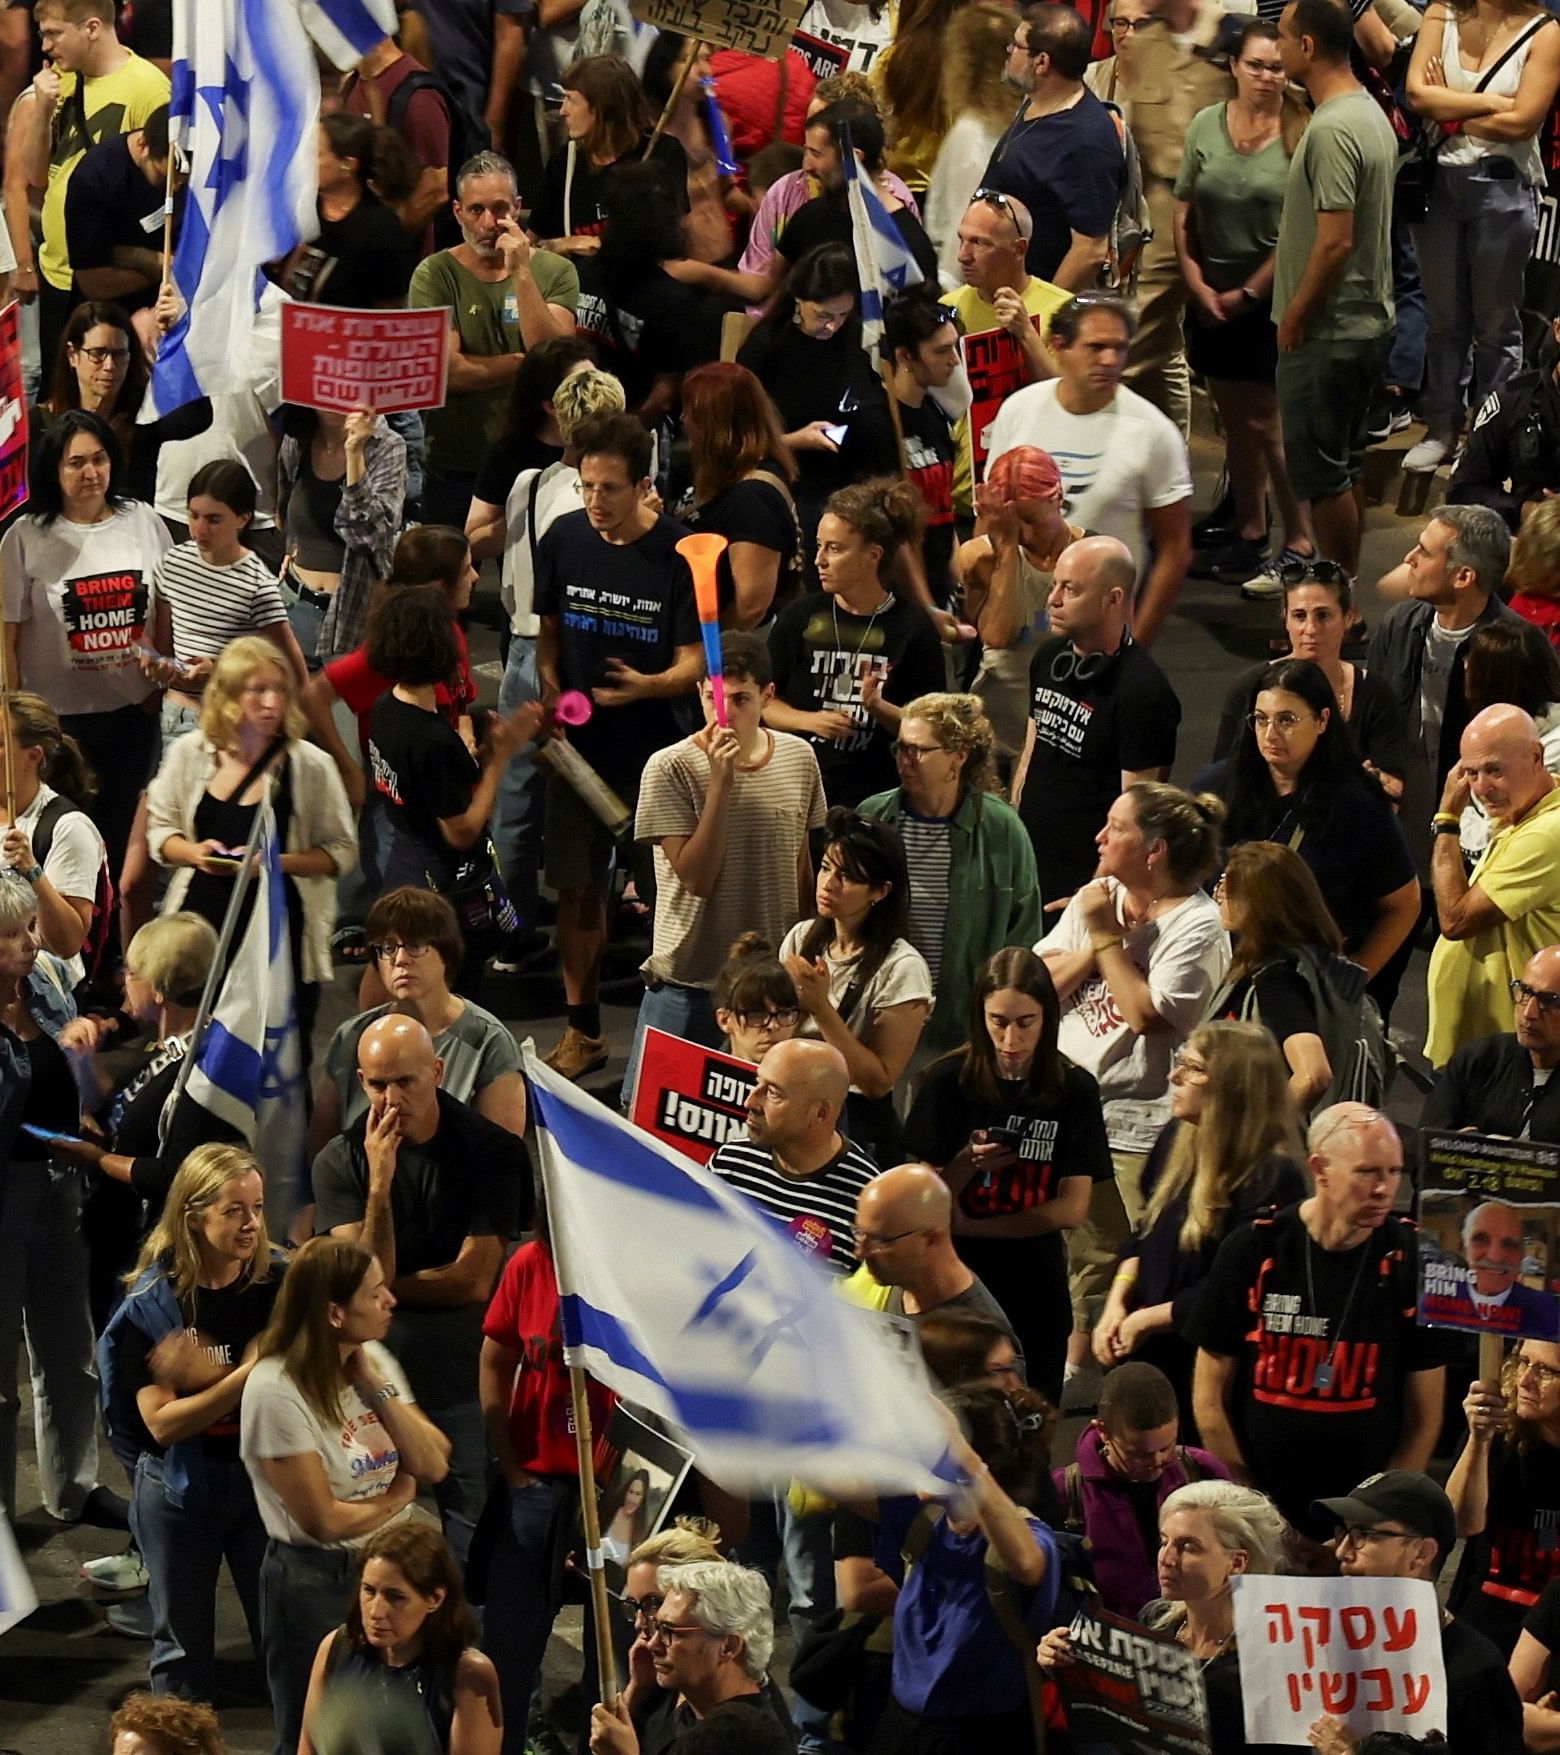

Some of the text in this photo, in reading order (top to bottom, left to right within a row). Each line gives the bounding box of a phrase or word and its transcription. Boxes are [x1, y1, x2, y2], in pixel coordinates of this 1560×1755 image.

[293, 312, 336, 334] את
[313, 375, 360, 406] שם
[75, 575, 135, 596] BRING
[82, 593, 132, 611] THEM
[80, 608, 136, 631] HOME
[811, 650, 889, 681] בחירות
[1067, 723, 1085, 743] עם
[1425, 1263, 1478, 1285] BRING
[1425, 1278, 1457, 1297] HIM
[1254, 1335, 1379, 1397] NOW!
[1265, 1603, 1418, 1669] עסקה
[1287, 1667, 1431, 1715] עכשיו
